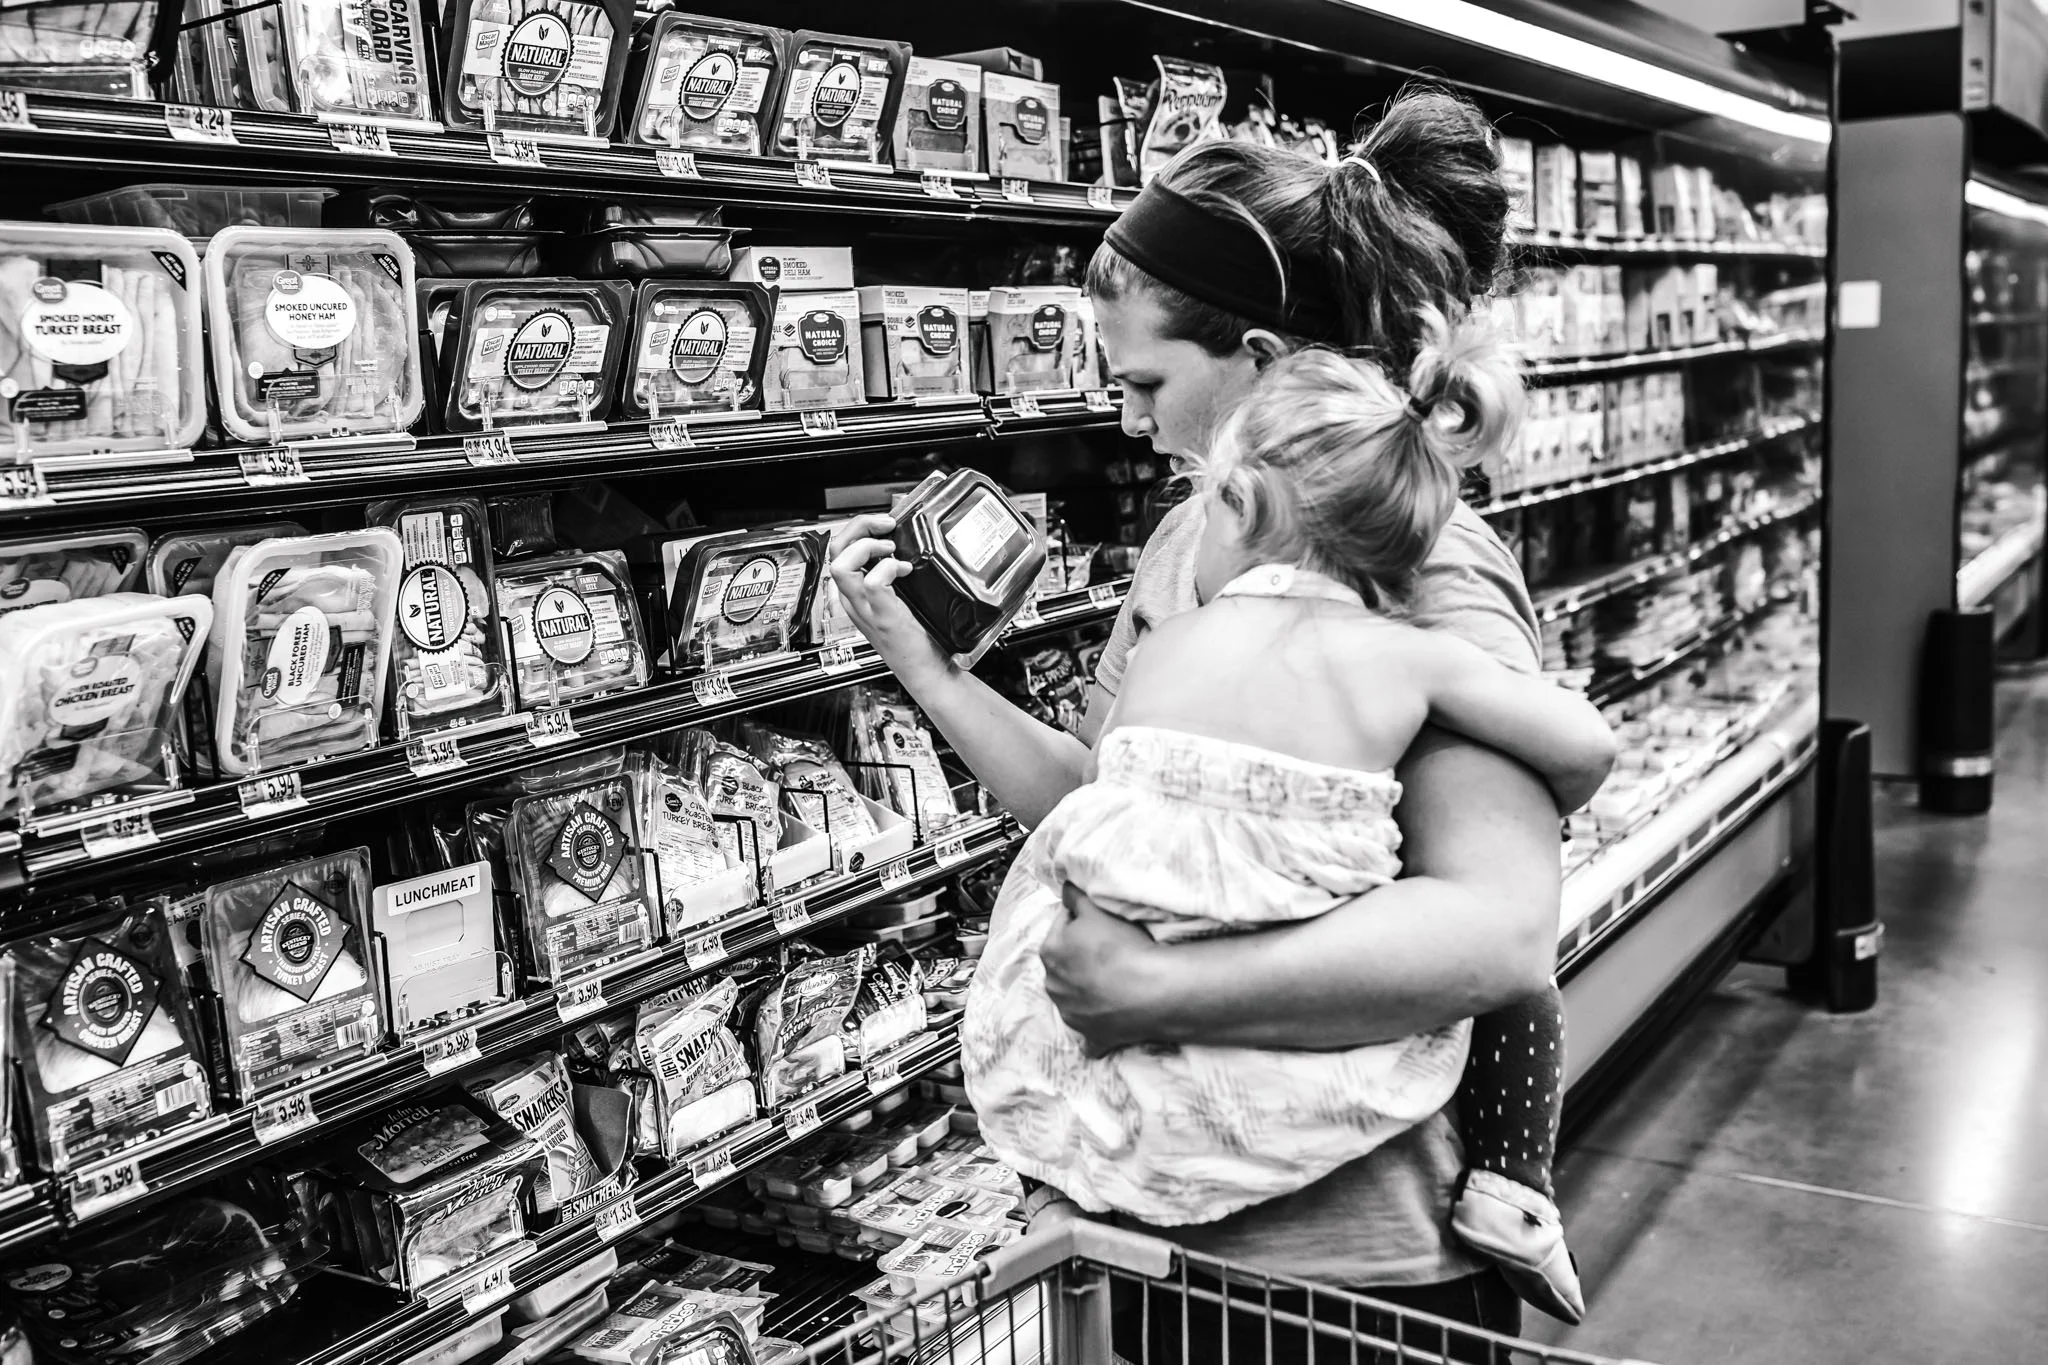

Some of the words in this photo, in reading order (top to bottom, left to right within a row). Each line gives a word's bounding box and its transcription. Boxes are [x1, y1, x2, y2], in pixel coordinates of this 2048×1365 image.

[390, 0, 417, 86] CARVING
[479, 38, 497, 48] Mayer
[480, 33, 498, 42] Oscar
[511, 44, 565, 67] NATURAL
[686, 76, 730, 95] NATURAL
[818, 87, 855, 104] NATURAL
[932, 97, 963, 109] NATURAL
[194, 107, 225, 131] 4.24
[936, 106, 959, 116] CHOICE
[1018, 113, 1046, 125] NATURAL
[1023, 122, 1043, 131] CHOICE
[783, 261, 808, 269] SMOKED
[275, 276, 299, 285] Great
[275, 303, 308, 312] SMOKED
[309, 302, 348, 311] UNCURED
[39, 314, 80, 324] SMOKED
[83, 314, 115, 324] HONEY
[289, 312, 317, 321] HONEY
[318, 312, 336, 320] HAM
[35, 325, 79, 336] TURKEY
[82, 324, 123, 335] BREAST
[805, 330, 841, 339] NATURAL
[923, 324, 955, 333] NATURAL
[929, 332, 952, 340] CHOICE
[513, 343, 566, 360] NATURAL
[677, 340, 721, 356] NATURAL
[812, 338, 837, 347] CHOICE
[481, 437, 510, 458] $3.94
[268, 450, 296, 473] 5.94
[579, 575, 599, 585] FAMILY
[585, 582, 598, 591] SIZE
[729, 582, 770, 600] NATURAL
[421, 571, 444, 643] NATURAL
[301, 623, 311, 645] HAM
[540, 613, 589, 638] NATURAL
[292, 626, 303, 658] FOREST
[288, 658, 298, 687] BLACK
[295, 646, 308, 687] UNCURED
[100, 683, 136, 698] BREAST
[263, 672, 274, 697] Great
[706, 677, 729, 697] $3.94
[543, 711, 569, 734] $5.94
[268, 774, 296, 801] 5.94
[662, 811, 690, 826] TURKEY
[561, 813, 584, 858] ARTISAN
[584, 811, 615, 847] CRAFTED
[576, 825, 596, 836] SERIES
[572, 872, 601, 887] PREMIUM
[600, 863, 612, 880] HAM
[395, 874, 476, 908] LUNCHMEAT
[260, 900, 291, 953] ARTISAN
[293, 897, 332, 937] CRAFTED
[280, 911, 307, 926] SERIES
[281, 936, 312, 949] KENTUCKY
[287, 940, 308, 950] LEGEND
[272, 965, 303, 986] TURKEY
[304, 952, 330, 983] BREAST
[63, 957, 95, 1015] ARTISAN
[95, 952, 144, 994] CRAFTED
[781, 1016, 812, 1045] BACON
[660, 1057, 679, 1078] DELI
[387, 1106, 414, 1124] John
[513, 1080, 567, 1132] SNACKERS
[375, 1105, 441, 1150] Morrell
[420, 1148, 445, 1167] Diced
[462, 1151, 478, 1162] Free
[572, 1175, 622, 1216] SNACKERS
[609, 1200, 633, 1224] $1.33
